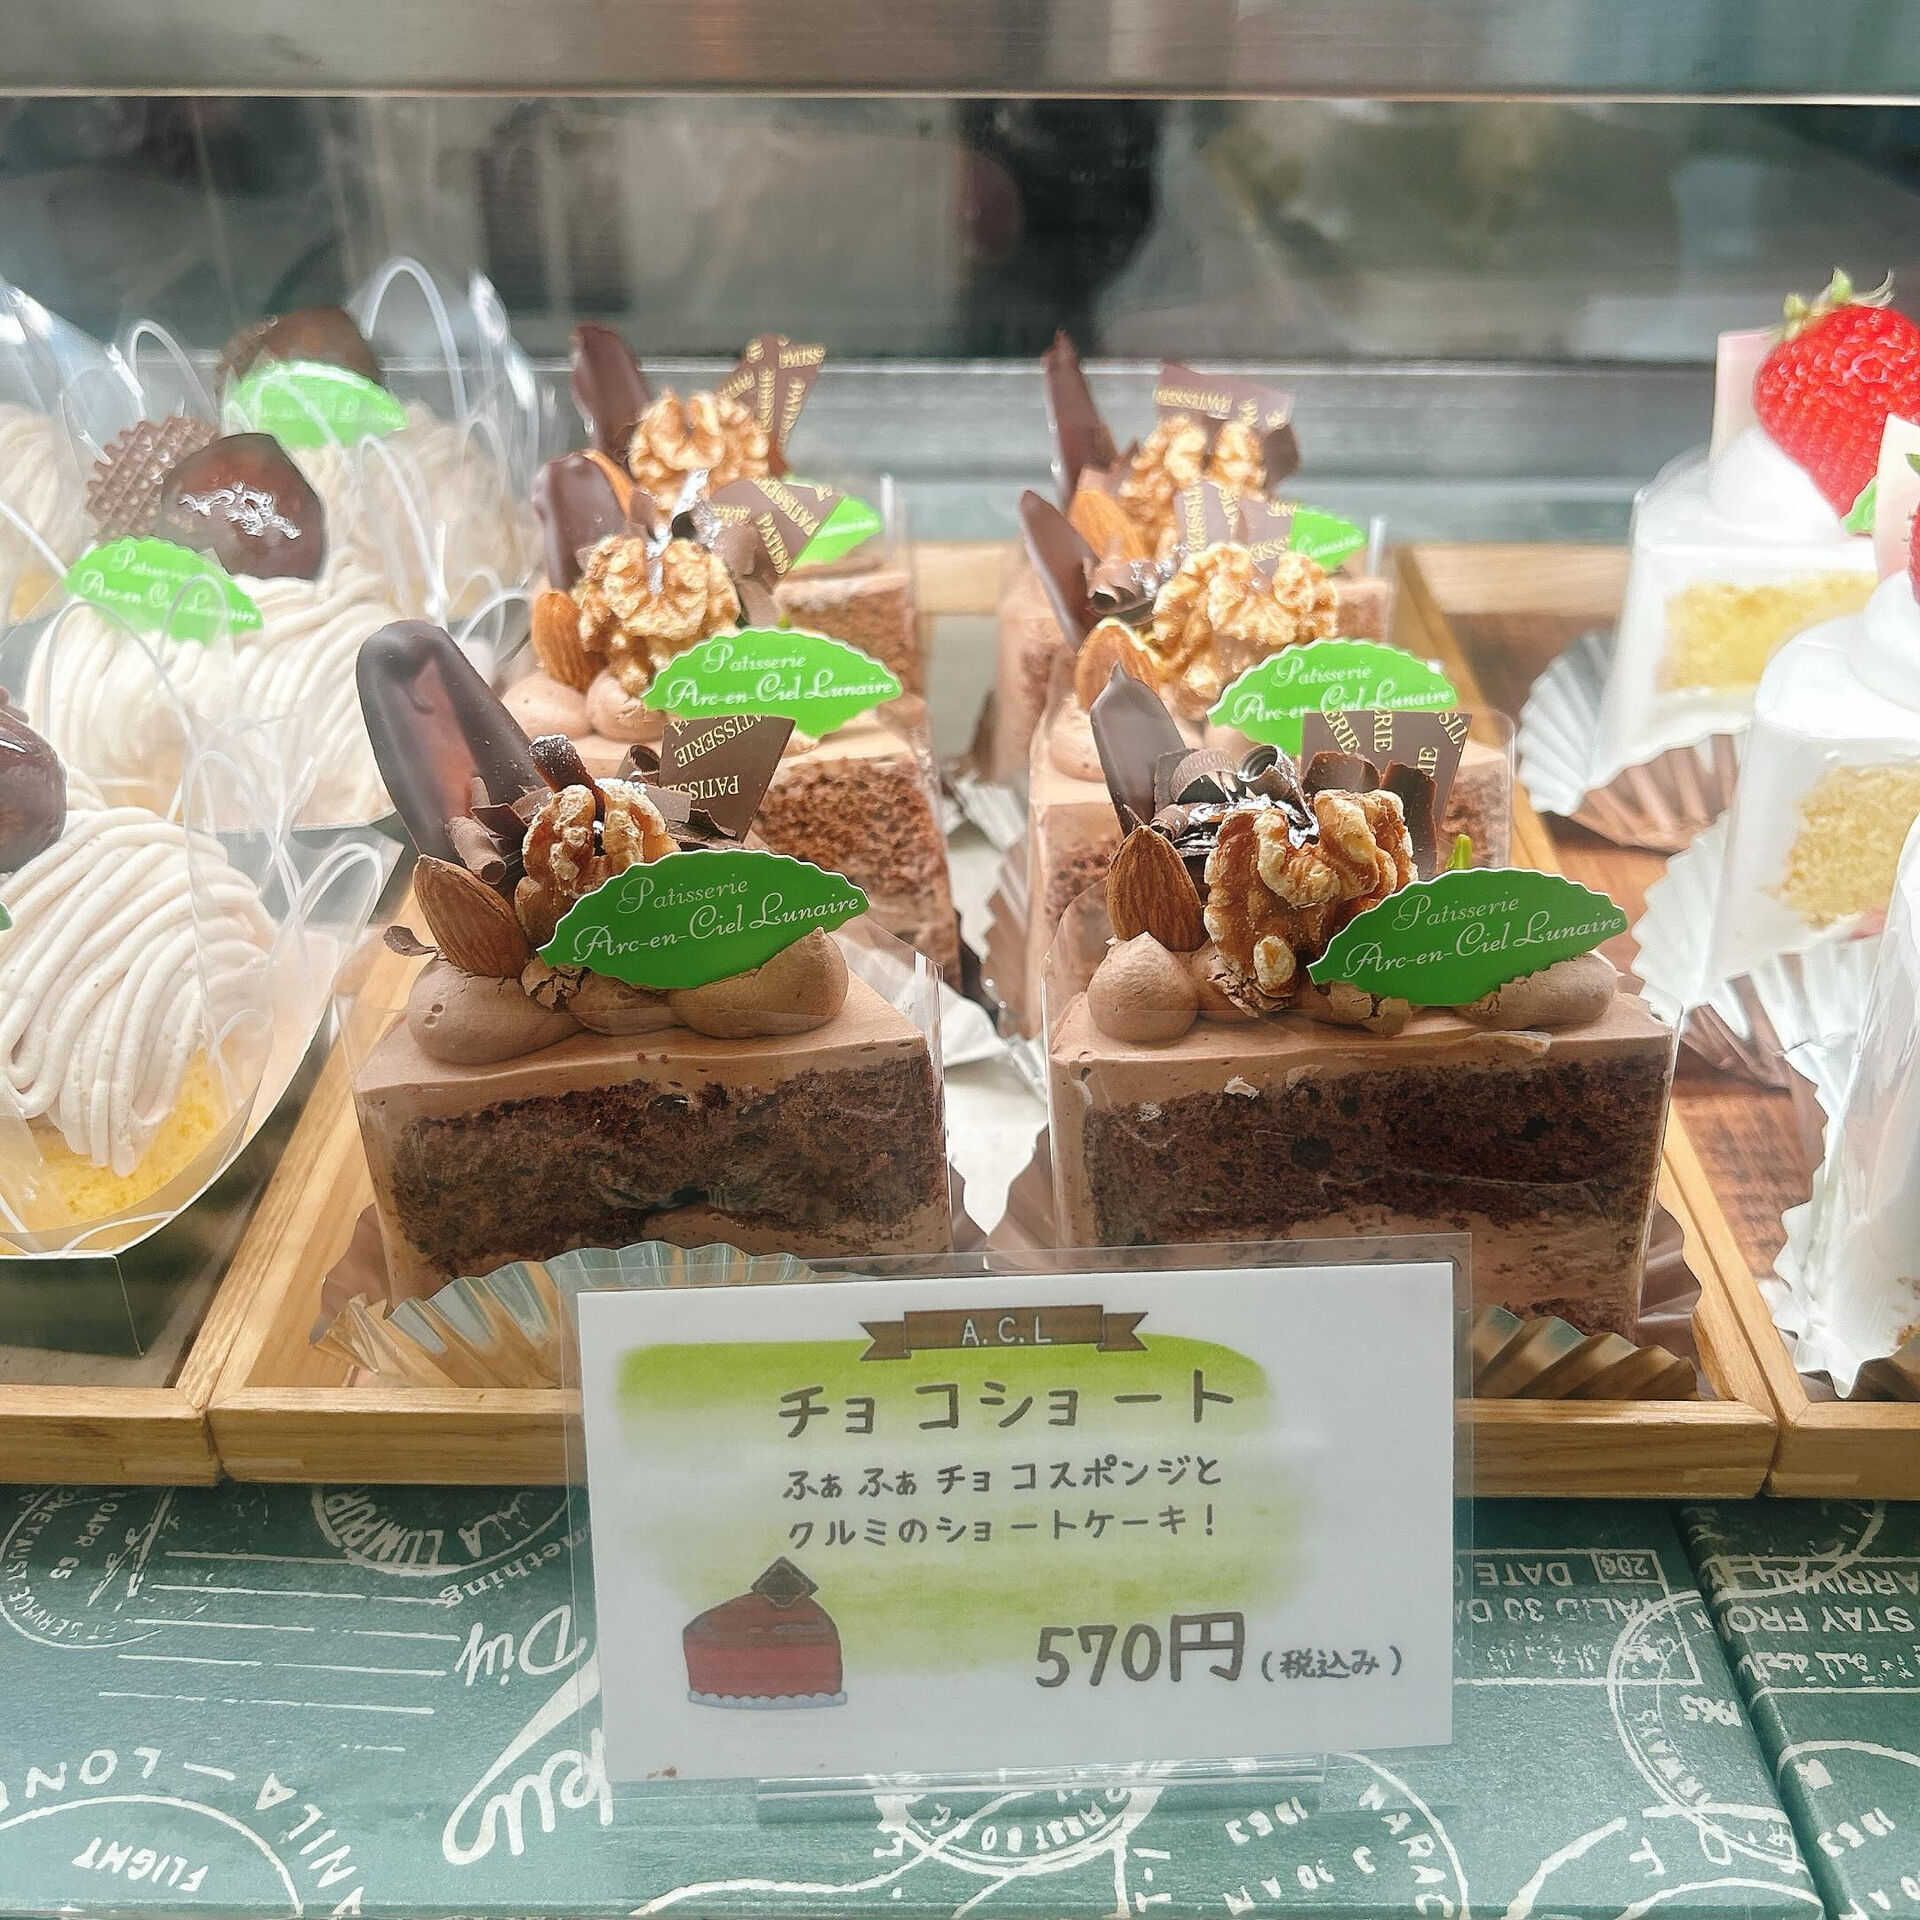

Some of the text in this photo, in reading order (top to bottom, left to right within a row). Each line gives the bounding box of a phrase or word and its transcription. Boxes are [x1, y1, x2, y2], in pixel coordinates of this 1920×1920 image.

[702, 642, 806, 674] Patisserie
[804, 671, 894, 698] Lunaire
[616, 873, 749, 915] Patisserie
[1391, 891, 1519, 932] Patisserie
[573, 892, 859, 963] Arc-en-Ciel Lunaire
[1342, 911, 1622, 979] Arc-en-Ciel Lunaire
[961, 1316, 1052, 1347] A.C.L
[778, 1369, 1235, 1439] チョコショート
[1473, 1561, 1574, 1588] DATE
[1820, 1605, 1916, 1634] STAY
[454, 1604, 588, 1687] Diy
[1035, 1611, 1246, 1689] 570円
[71, 1836, 209, 1893] FLIGHT
